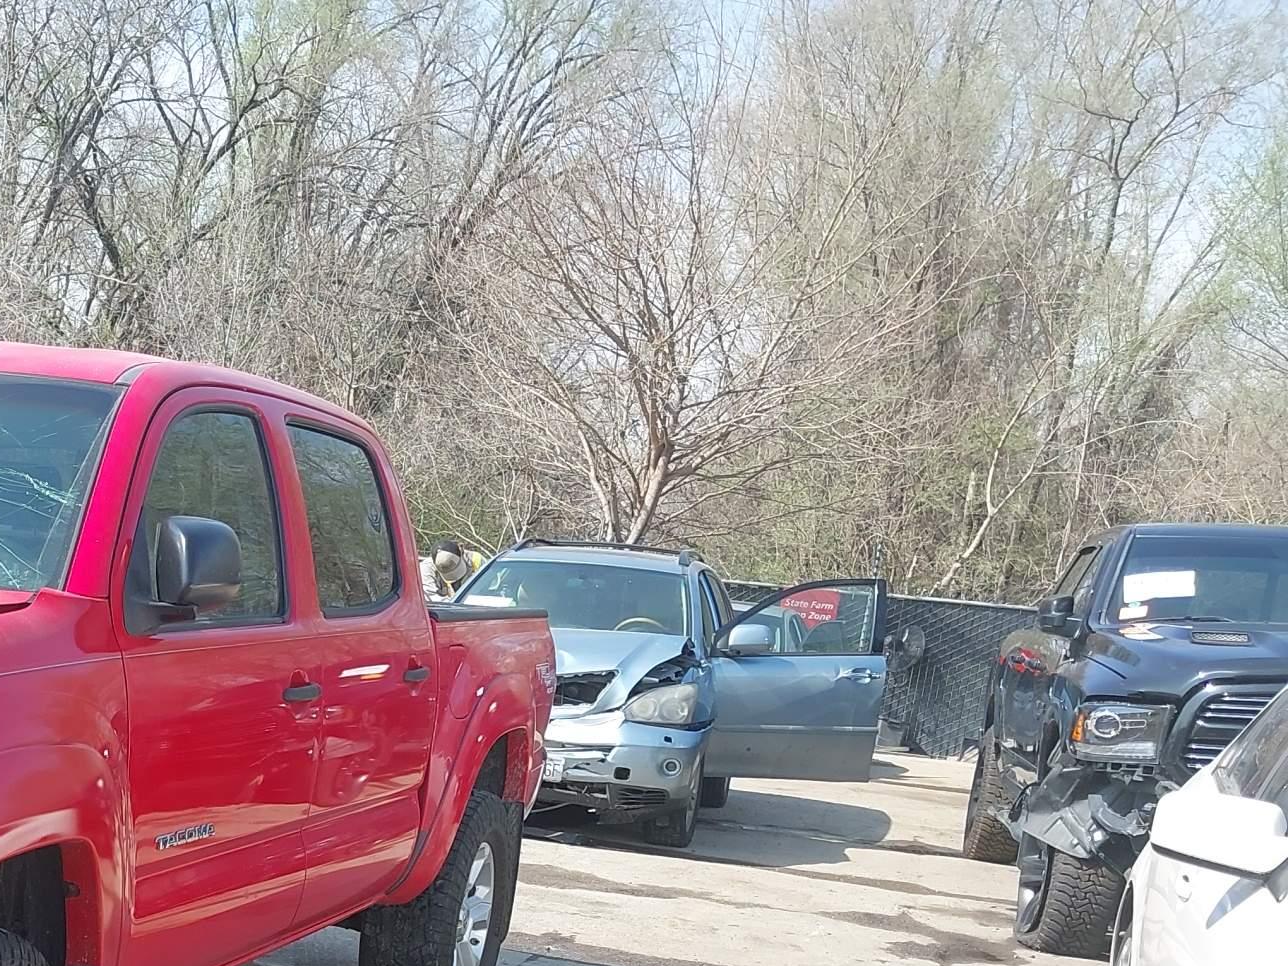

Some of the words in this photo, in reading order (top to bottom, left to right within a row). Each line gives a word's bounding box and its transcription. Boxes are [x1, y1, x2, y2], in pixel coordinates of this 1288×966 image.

[784, 598, 809, 608] State
[810, 600, 834, 610] Farm
[807, 611, 832, 621] Zone
[155, 822, 216, 850] TACOMA
